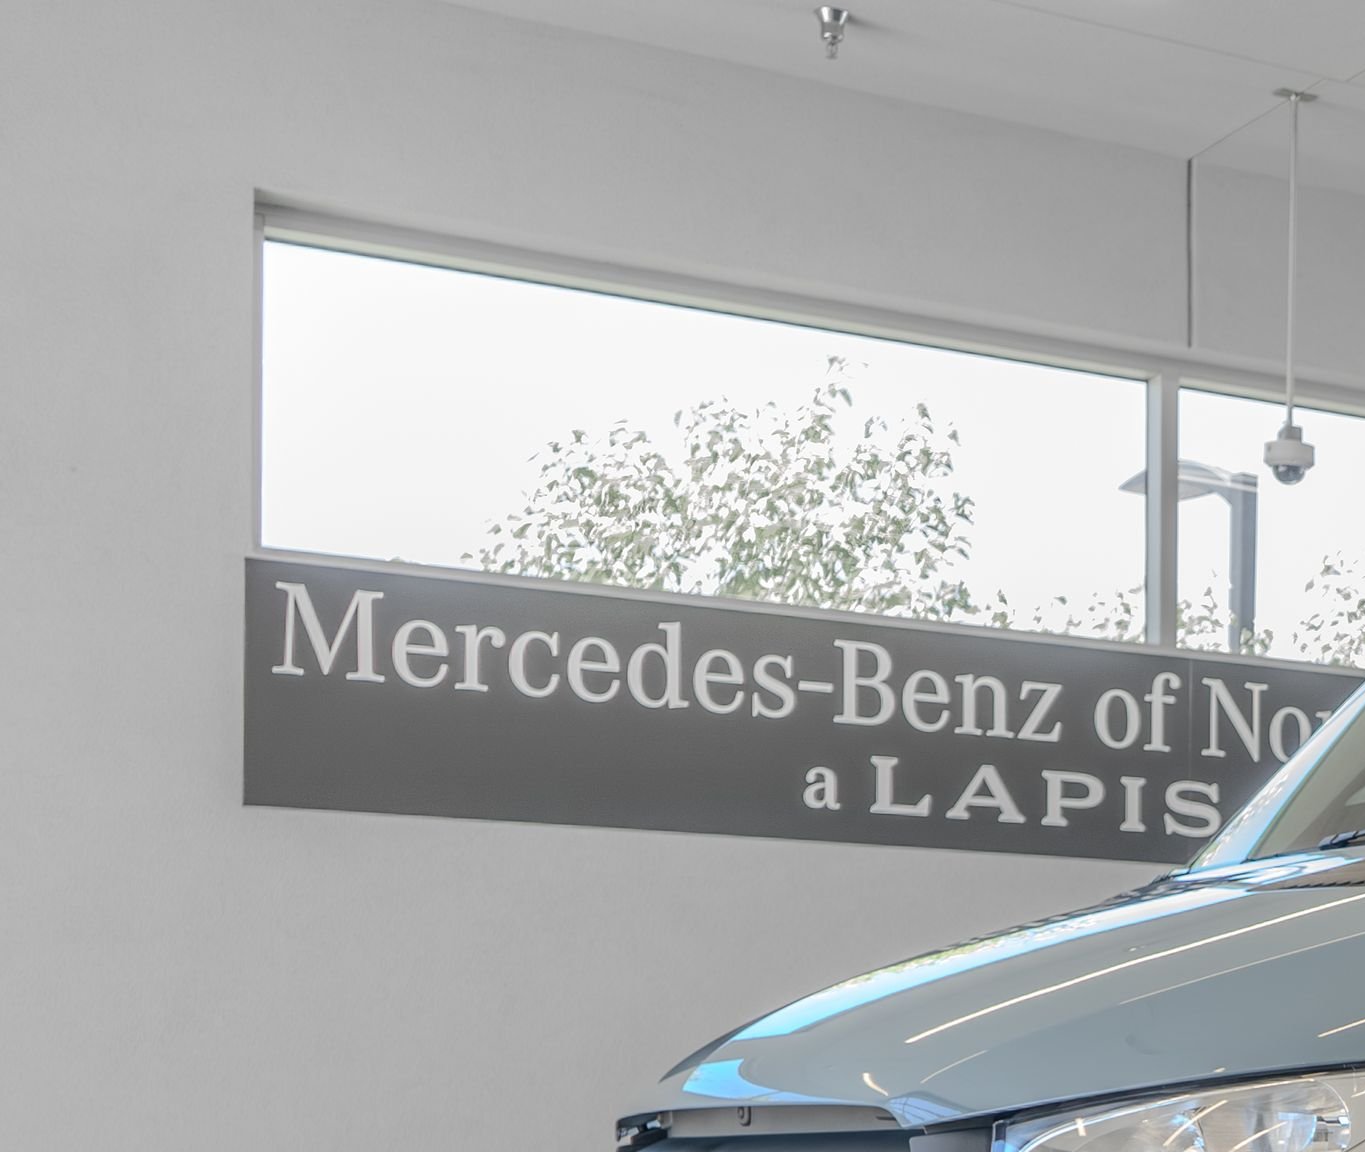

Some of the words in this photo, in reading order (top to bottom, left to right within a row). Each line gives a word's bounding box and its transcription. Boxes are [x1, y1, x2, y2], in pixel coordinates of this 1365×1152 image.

[272, 581, 1063, 743] Mercedes-Benz
[1093, 671, 1182, 752] of
[1200, 677, 1334, 764] No
[802, 764, 841, 810] a
[867, 754, 1222, 838] LAPIS
